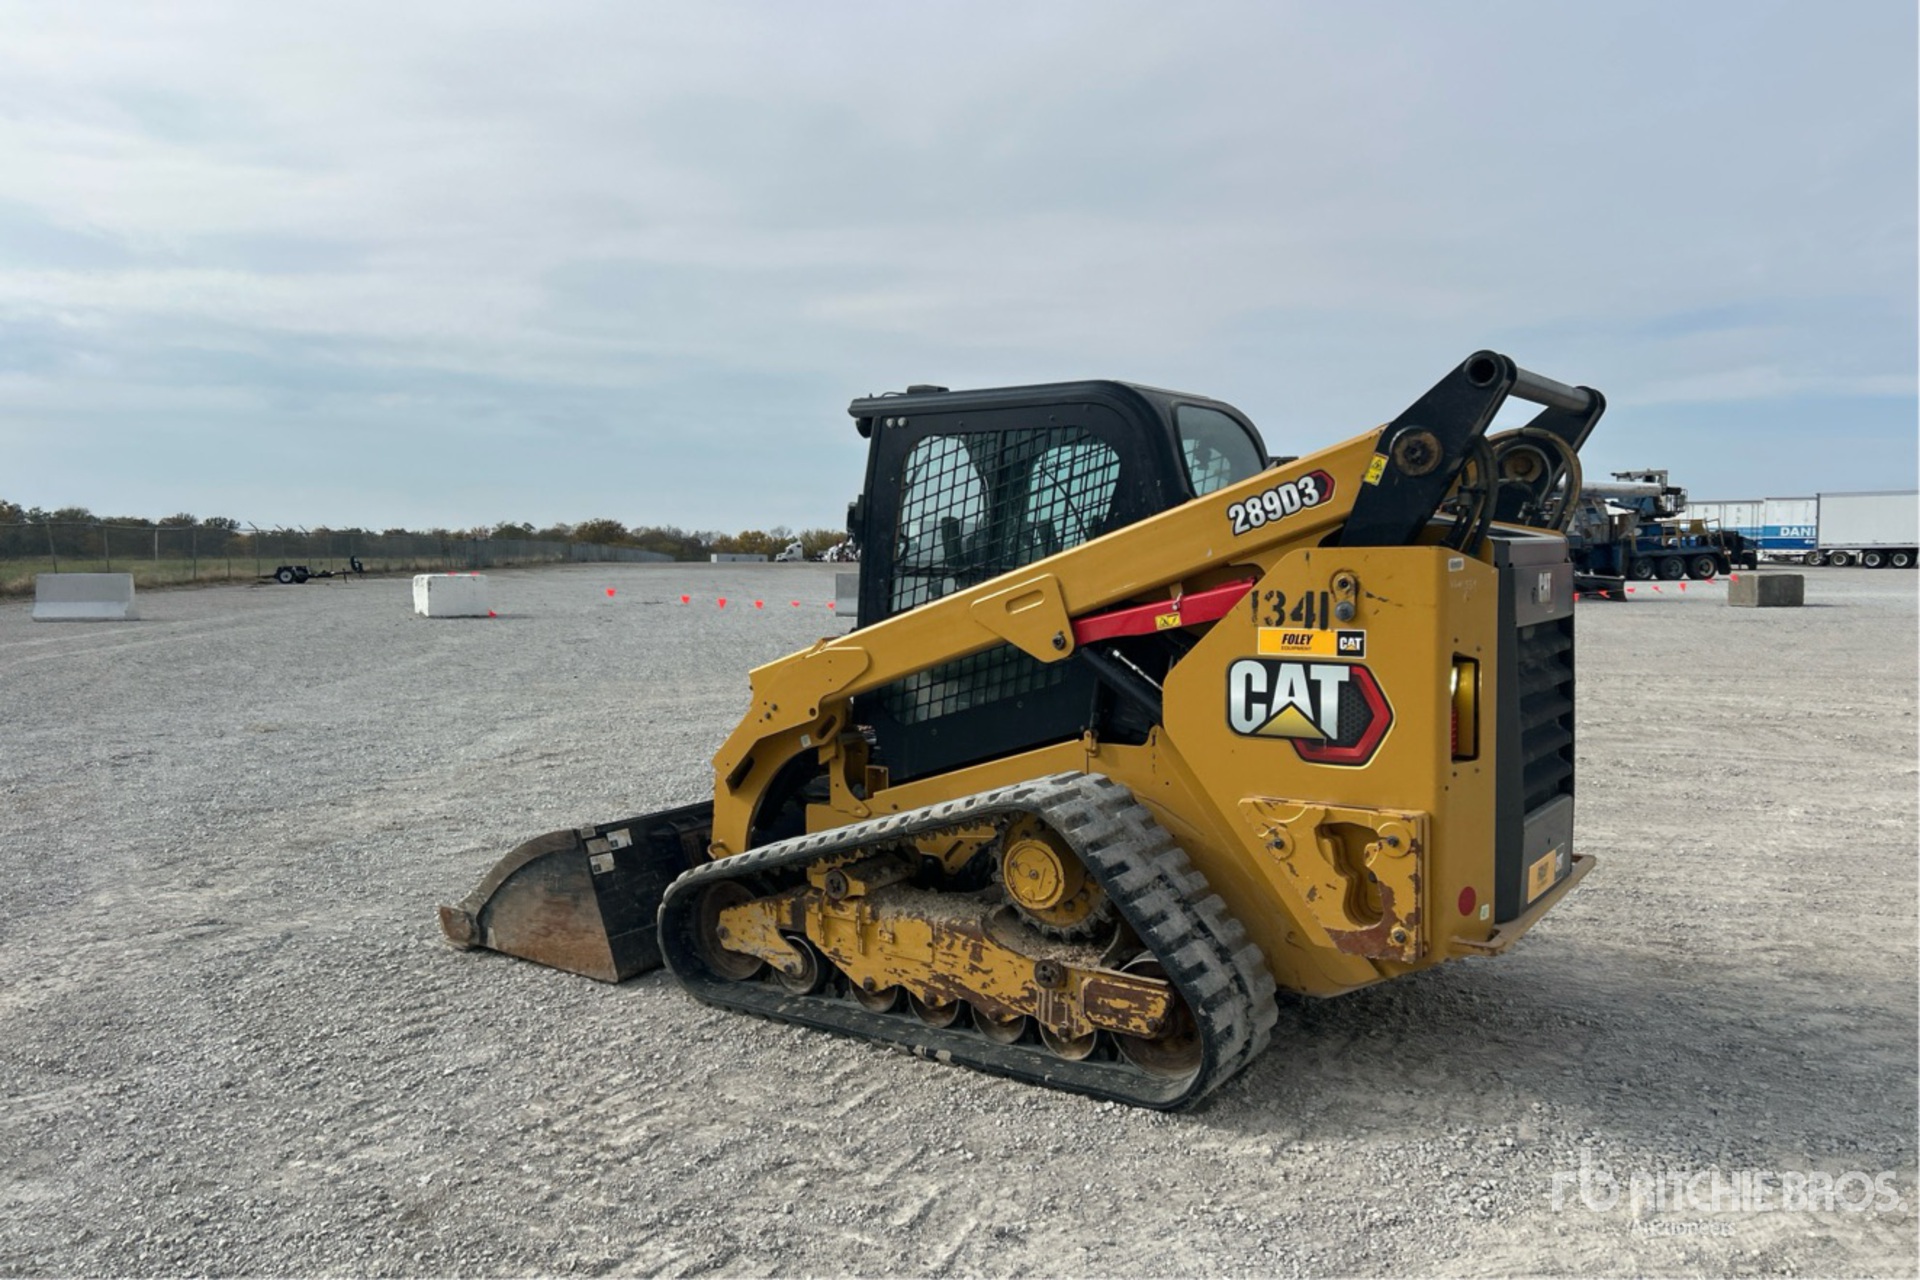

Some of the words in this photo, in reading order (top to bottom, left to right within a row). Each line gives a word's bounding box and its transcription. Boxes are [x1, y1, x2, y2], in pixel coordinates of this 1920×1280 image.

[1228, 476, 1320, 535] 289D3
[1281, 633, 1313, 645] FOLEY
[1340, 637, 1362, 651] CAT
[1230, 660, 1350, 740] CAT
